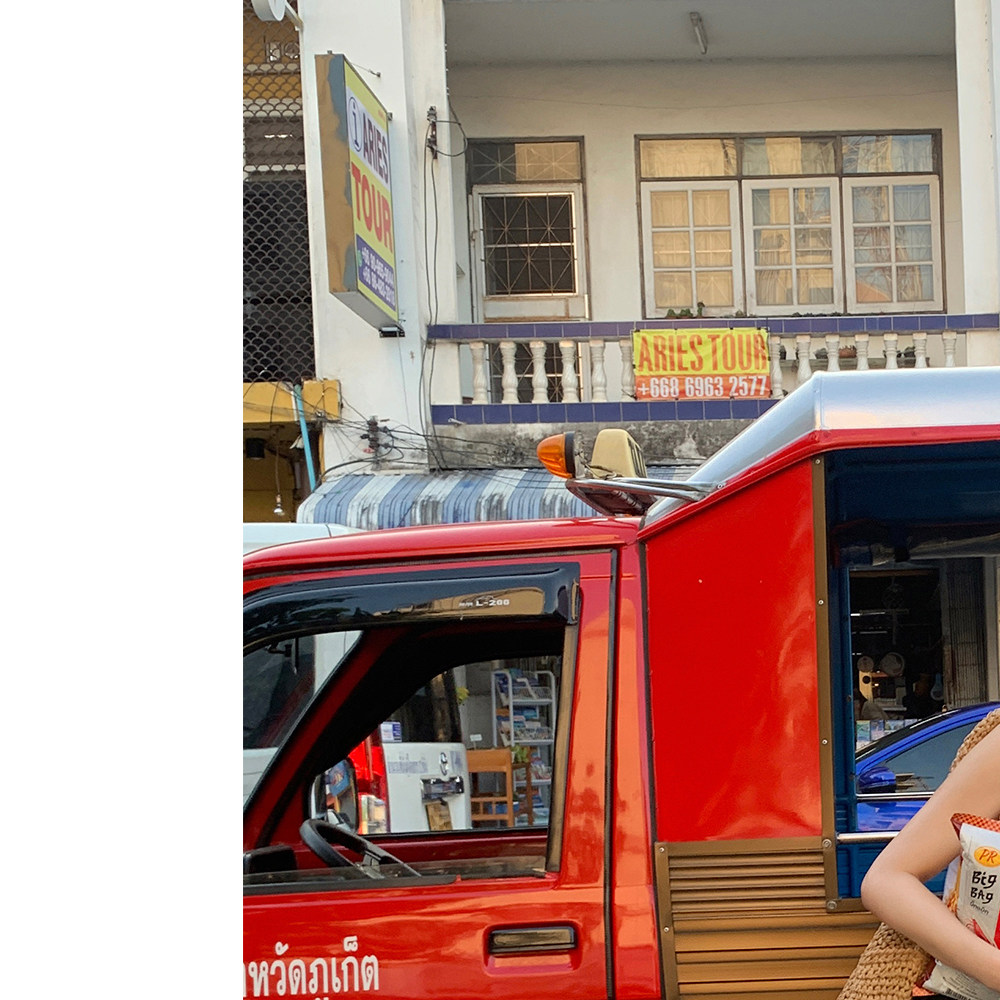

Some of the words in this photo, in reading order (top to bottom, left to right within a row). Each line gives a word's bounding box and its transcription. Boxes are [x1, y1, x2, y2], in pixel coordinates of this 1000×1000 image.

[363, 113, 388, 184] ARIES
[351, 162, 393, 253] TOUR
[639, 334, 704, 371] ARIES
[708, 334, 767, 371] TOUR
[638, 377, 679, 397] +668
[685, 376, 724, 397] 6963
[729, 375, 767, 396] 2577
[979, 848, 998, 864] PR
